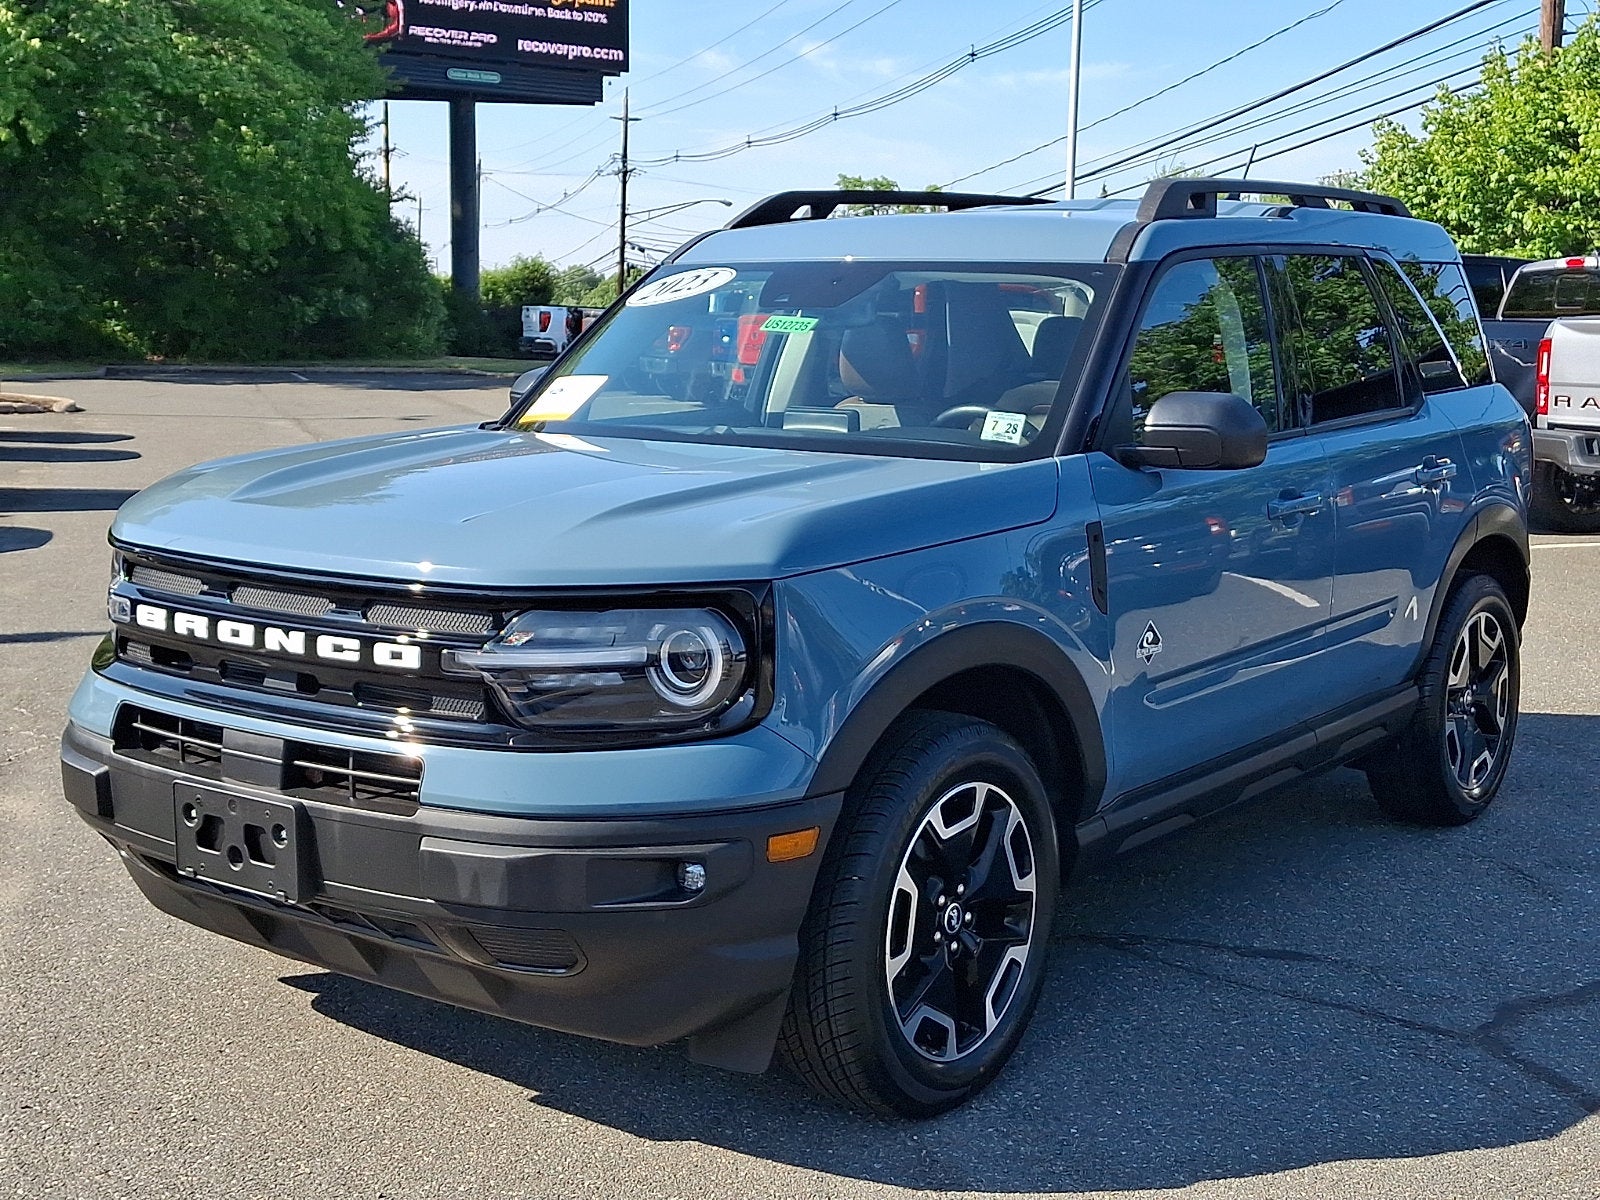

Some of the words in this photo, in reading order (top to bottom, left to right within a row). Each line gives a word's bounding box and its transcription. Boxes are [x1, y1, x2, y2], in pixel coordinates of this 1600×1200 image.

[409, 25, 469, 40] RECOVER
[470, 31, 498, 44] PRO
[517, 39, 624, 60] recoverpro.com
[764, 319, 812, 331] US12735
[991, 420, 999, 431] 7
[1004, 422, 1019, 435] 28
[135, 603, 422, 669] BRONCO
